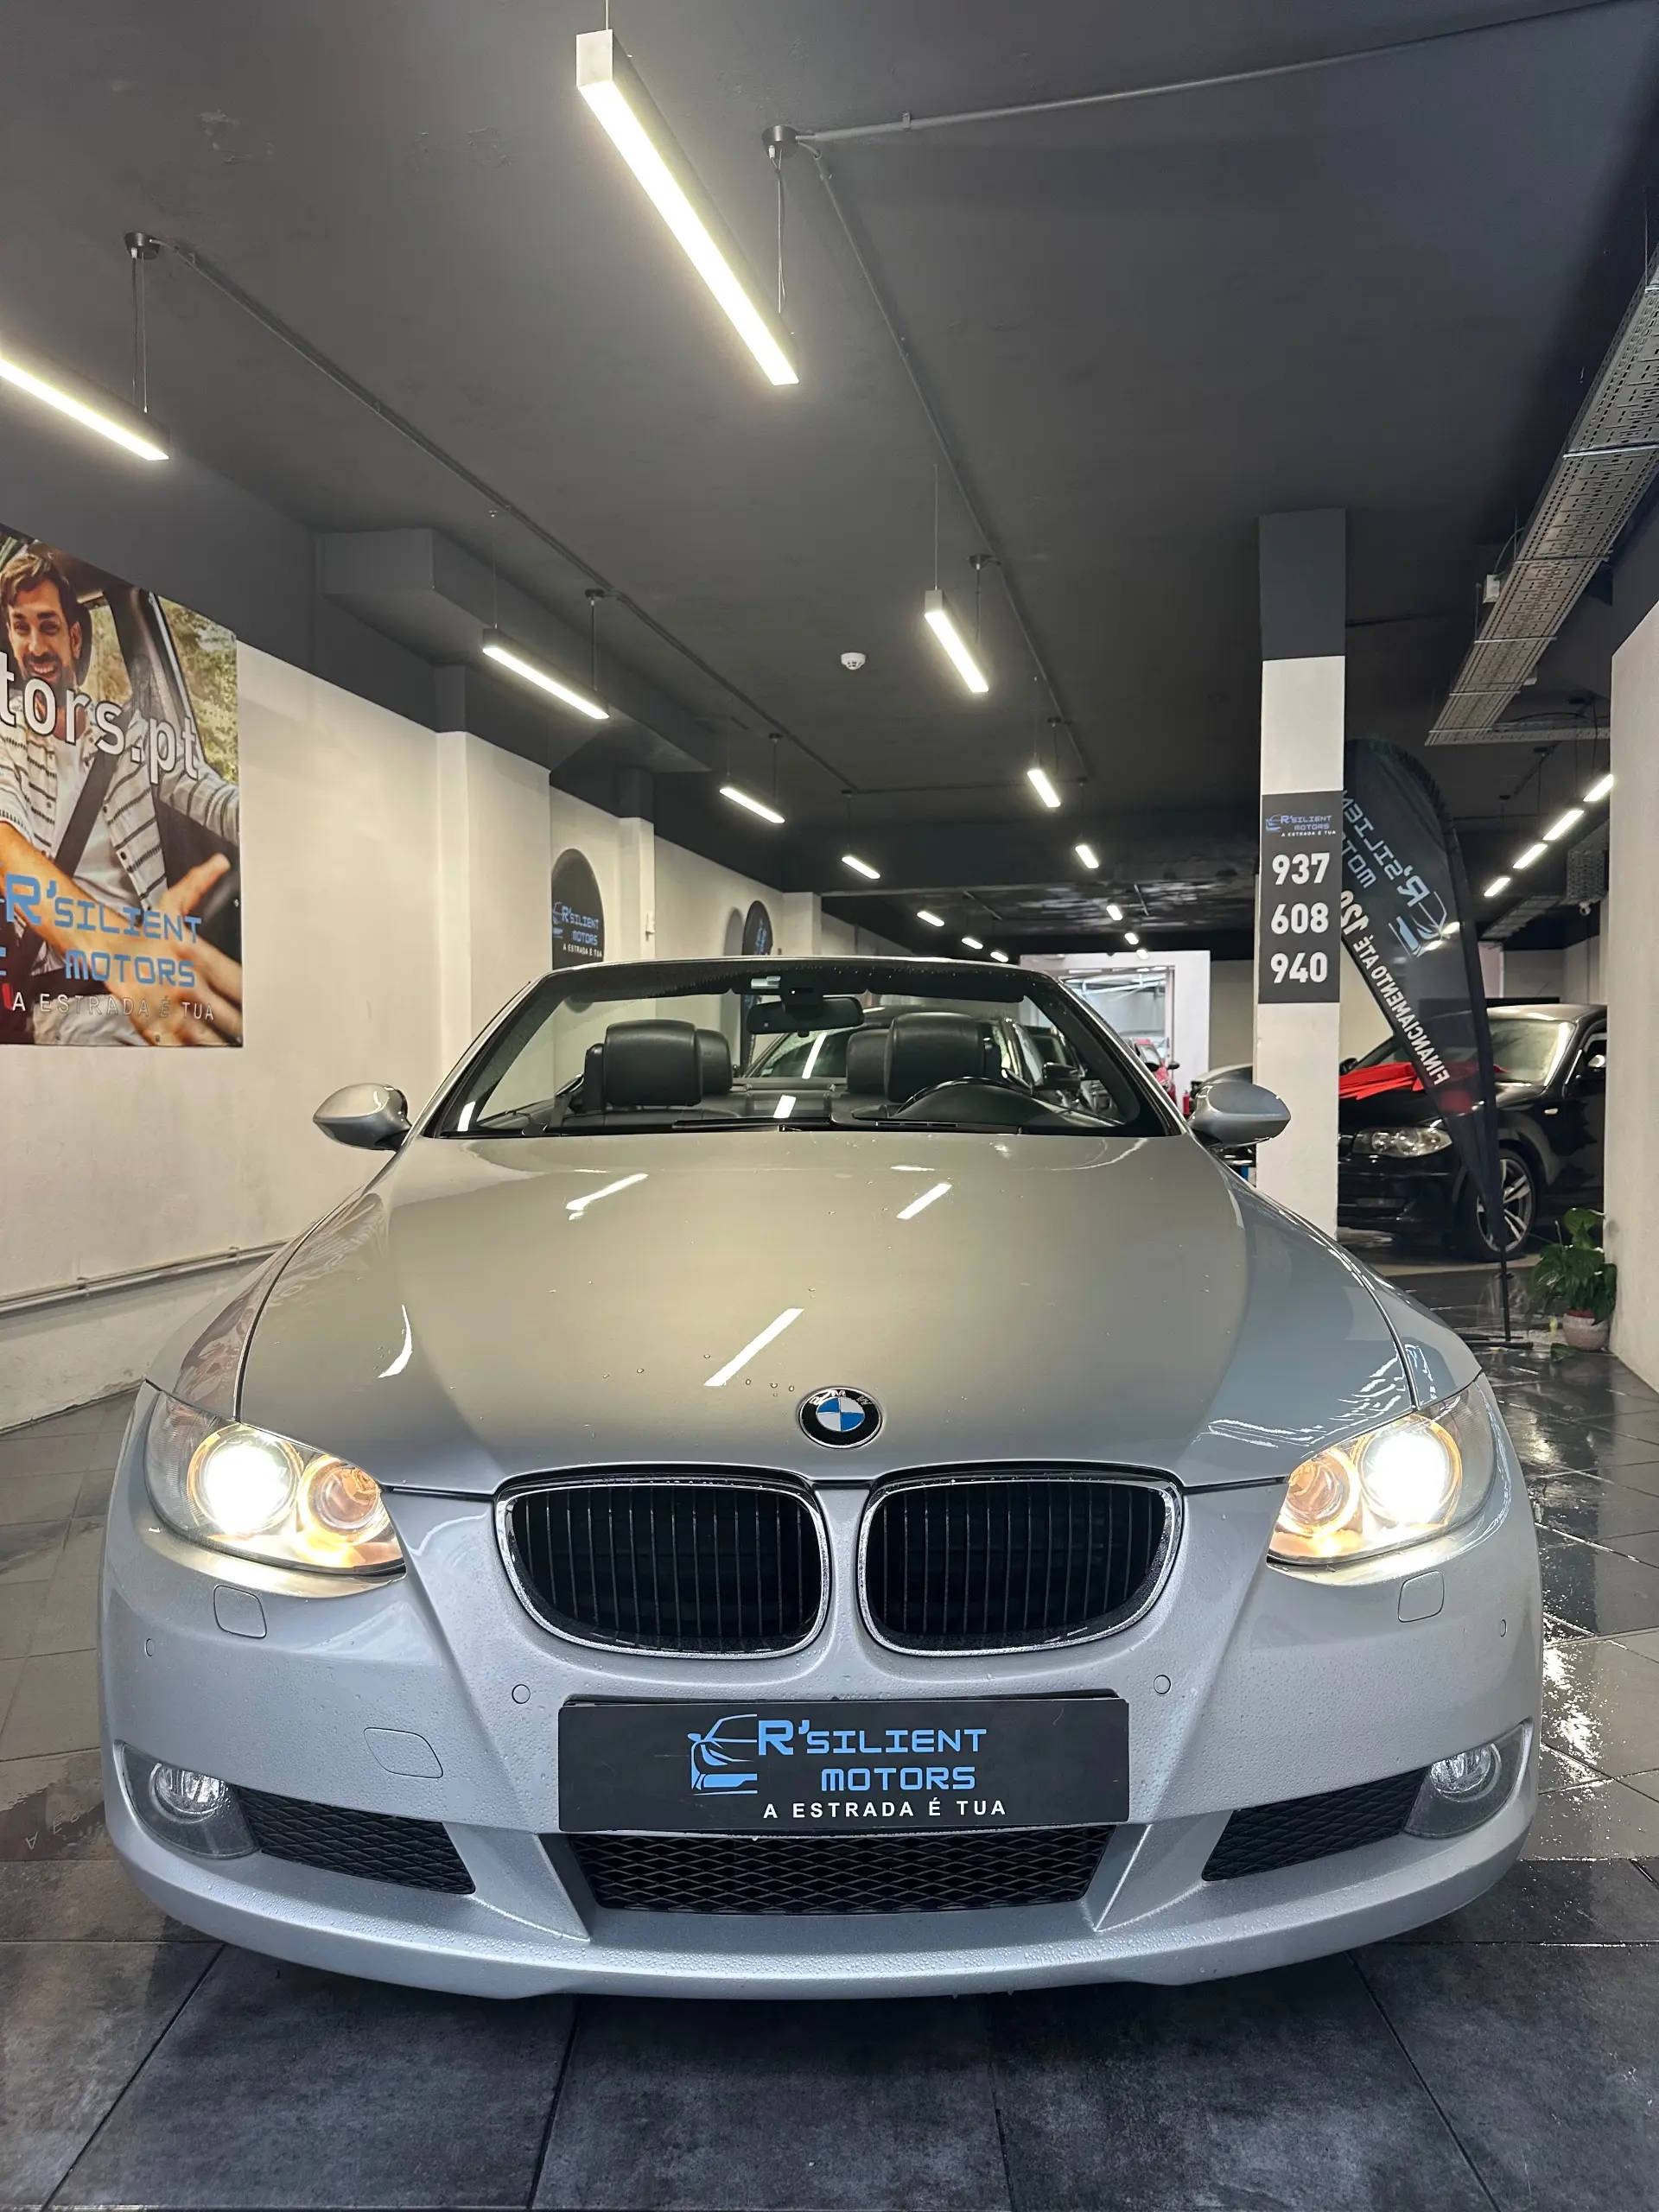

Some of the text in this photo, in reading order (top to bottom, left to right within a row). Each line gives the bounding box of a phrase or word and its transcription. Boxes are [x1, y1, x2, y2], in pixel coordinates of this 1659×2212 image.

[1272, 852, 1330, 885] 937
[6, 873, 201, 944] R'SILIENT
[1271, 902, 1329, 934] 608
[568, 944, 588, 955] ESTRADA
[594, 949, 602, 957] TUA
[572, 930, 598, 946] MOTORS
[65, 948, 195, 988] MOTORS
[1270, 951, 1328, 983] 940
[12, 992, 214, 1021] A ESTRADA É TUA
[758, 1719, 987, 1756] R'SILIENT
[821, 1766, 976, 1791] MOTORS
[763, 1796, 1006, 1819] A ESTRADA É TUA
